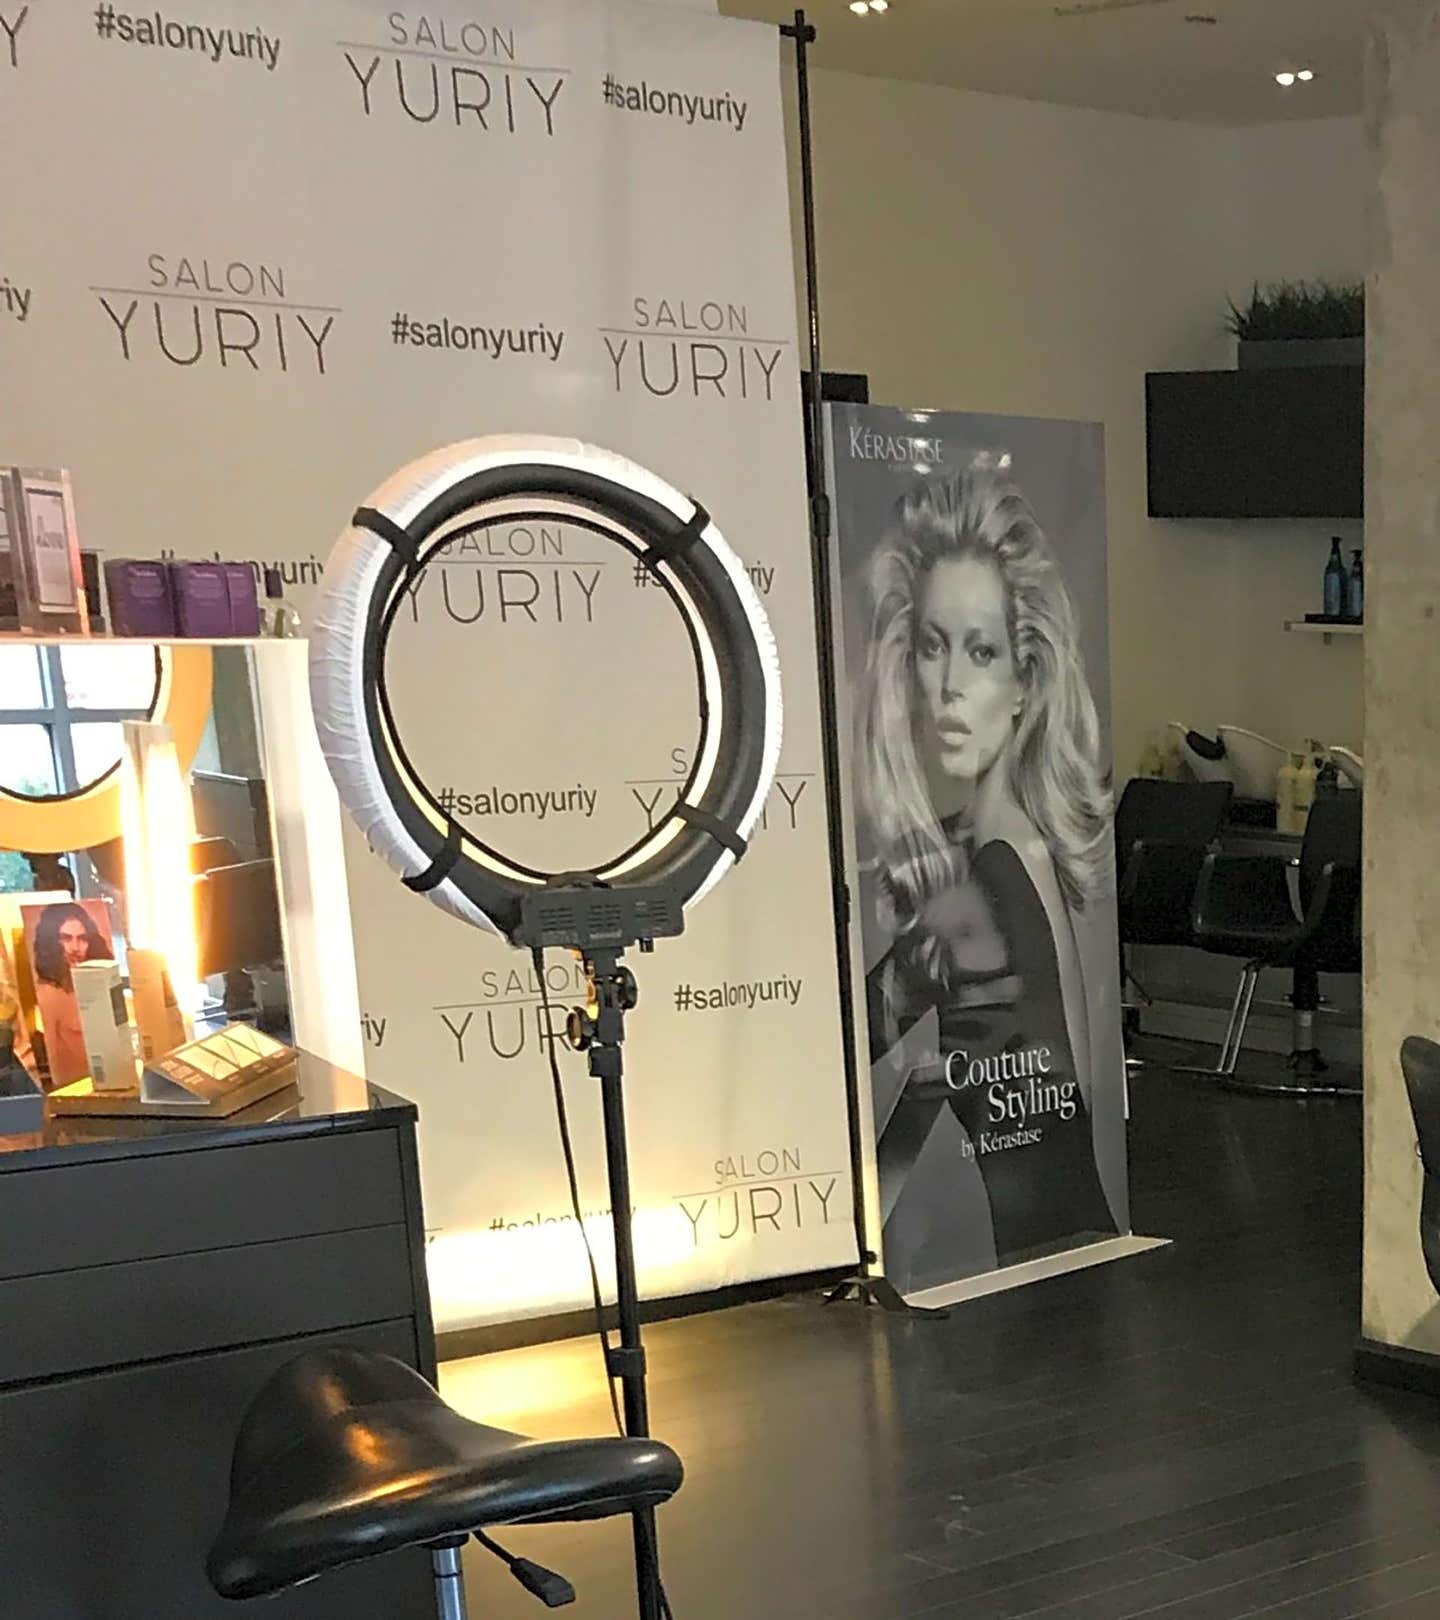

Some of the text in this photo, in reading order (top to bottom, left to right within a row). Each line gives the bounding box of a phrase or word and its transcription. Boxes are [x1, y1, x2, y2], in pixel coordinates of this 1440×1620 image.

[94, 3, 281, 69] #salonyuriy
[389, 12, 515, 61] SALON
[344, 52, 564, 136] YURIY
[602, 73, 748, 131] #salonyuriy
[148, 254, 285, 298] SALON
[100, 297, 334, 375] YURIY
[391, 312, 564, 361] #salonyuriy
[634, 298, 748, 333] SALON
[603, 338, 782, 400] YURIY
[408, 568, 601, 623] YURIY
[437, 784, 597, 819] #salonyuriy
[673, 975, 802, 1012] #salonyuriy
[441, 1003, 572, 1063] YUR
[945, 1047, 1050, 1090] Couture
[988, 1078, 1077, 1128] Styling
[714, 1148, 802, 1186] SALON
[960, 1127, 1043, 1162] by Kérastase
[679, 1178, 837, 1246] YURIY
